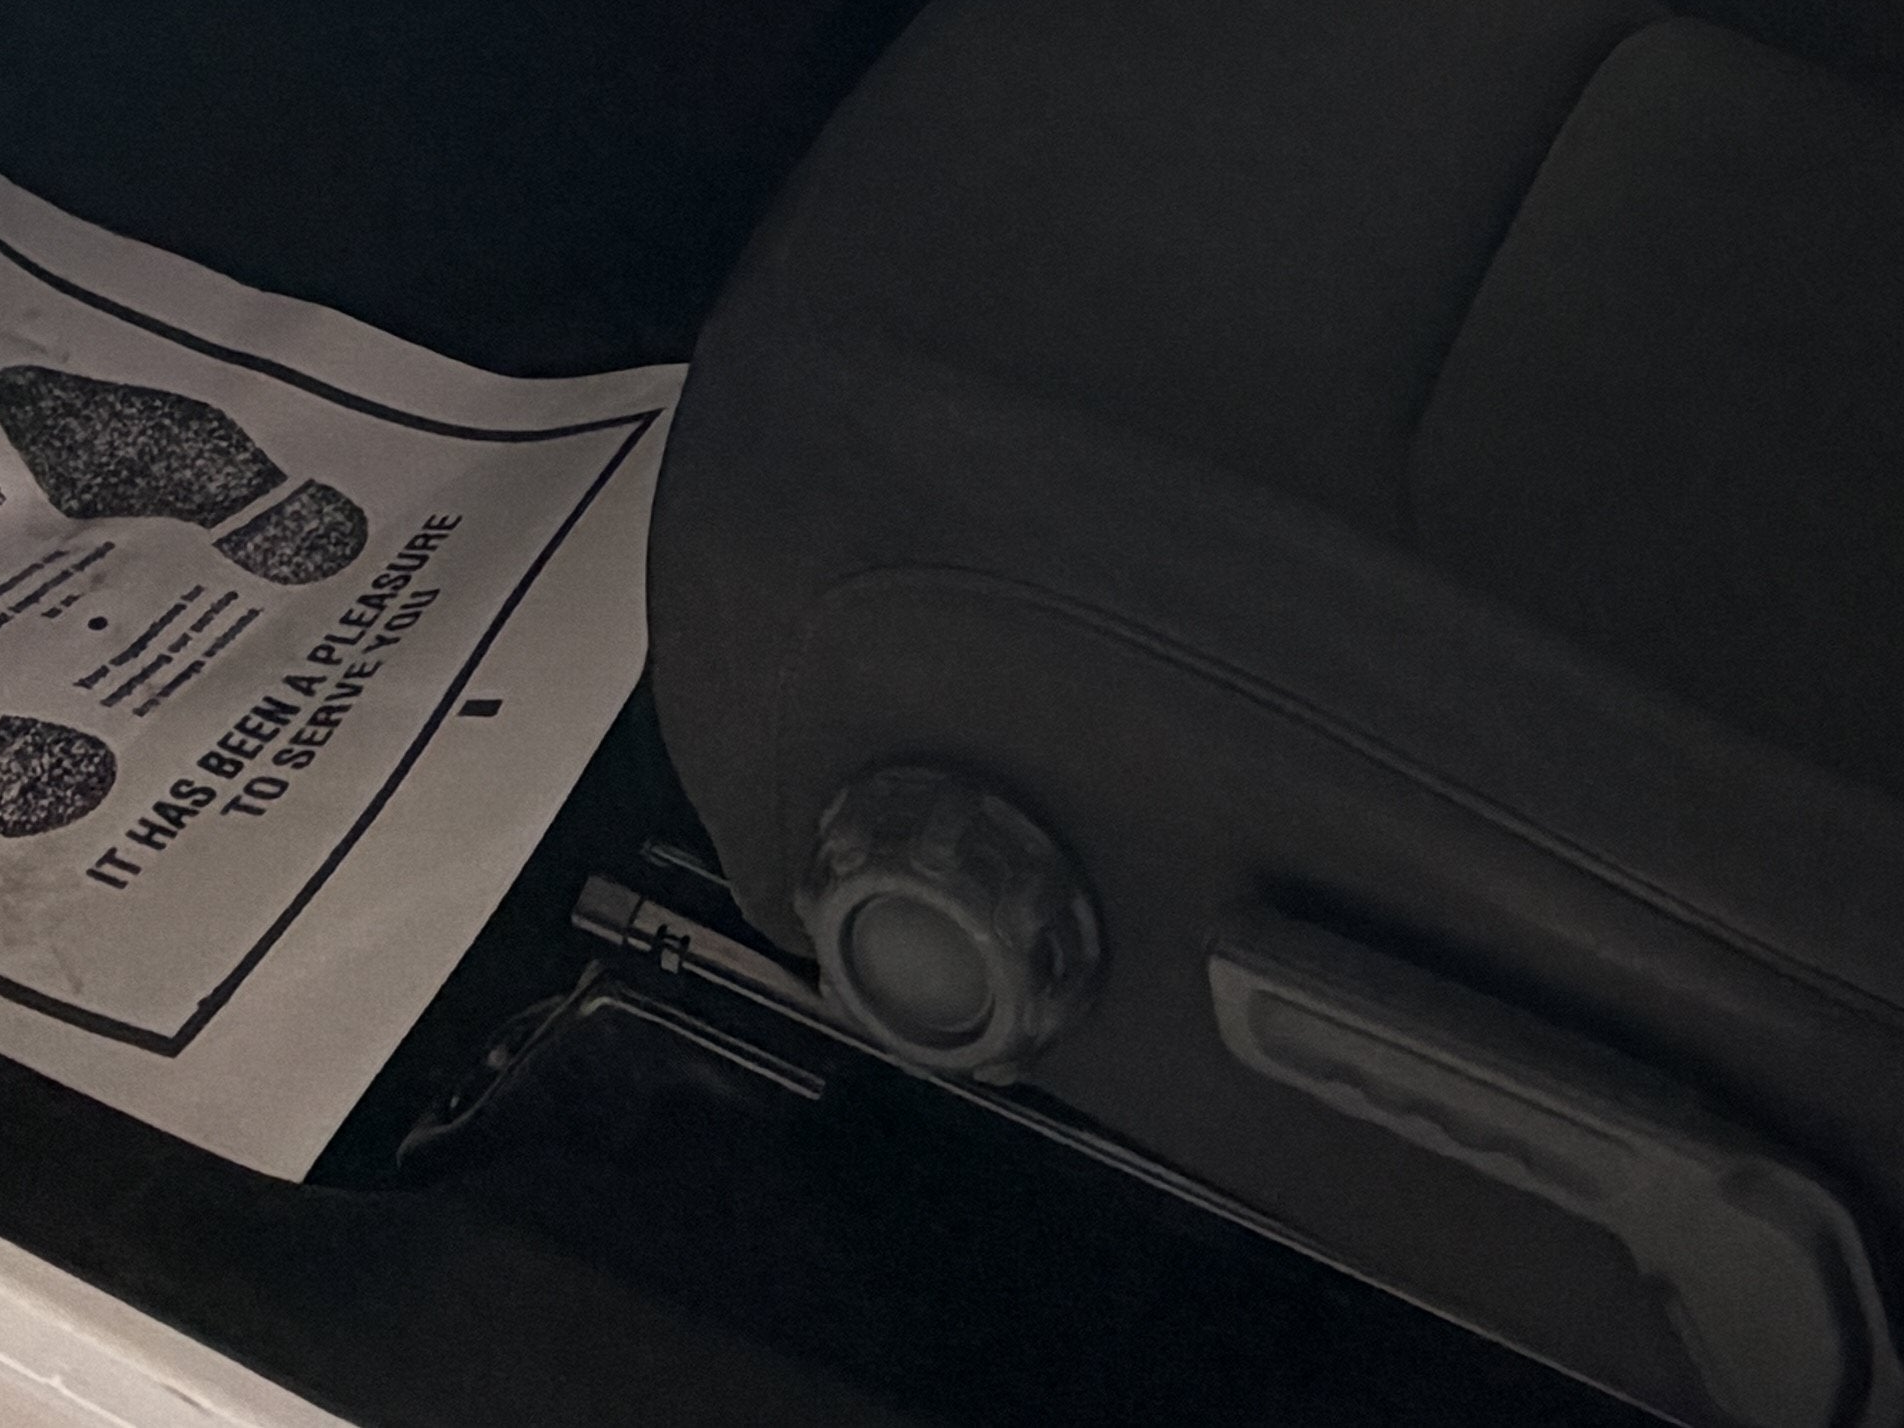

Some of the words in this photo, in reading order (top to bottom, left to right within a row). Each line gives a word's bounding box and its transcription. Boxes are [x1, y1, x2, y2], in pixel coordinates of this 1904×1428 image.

[86, 847, 142, 889] IT
[125, 779, 217, 851] HAS
[197, 696, 302, 780] BEEN
[282, 674, 327, 697] A
[307, 513, 463, 667] PLEASURE
[220, 776, 290, 818] TO
[272, 659, 385, 770] SERVE
[361, 587, 441, 655] YOU
